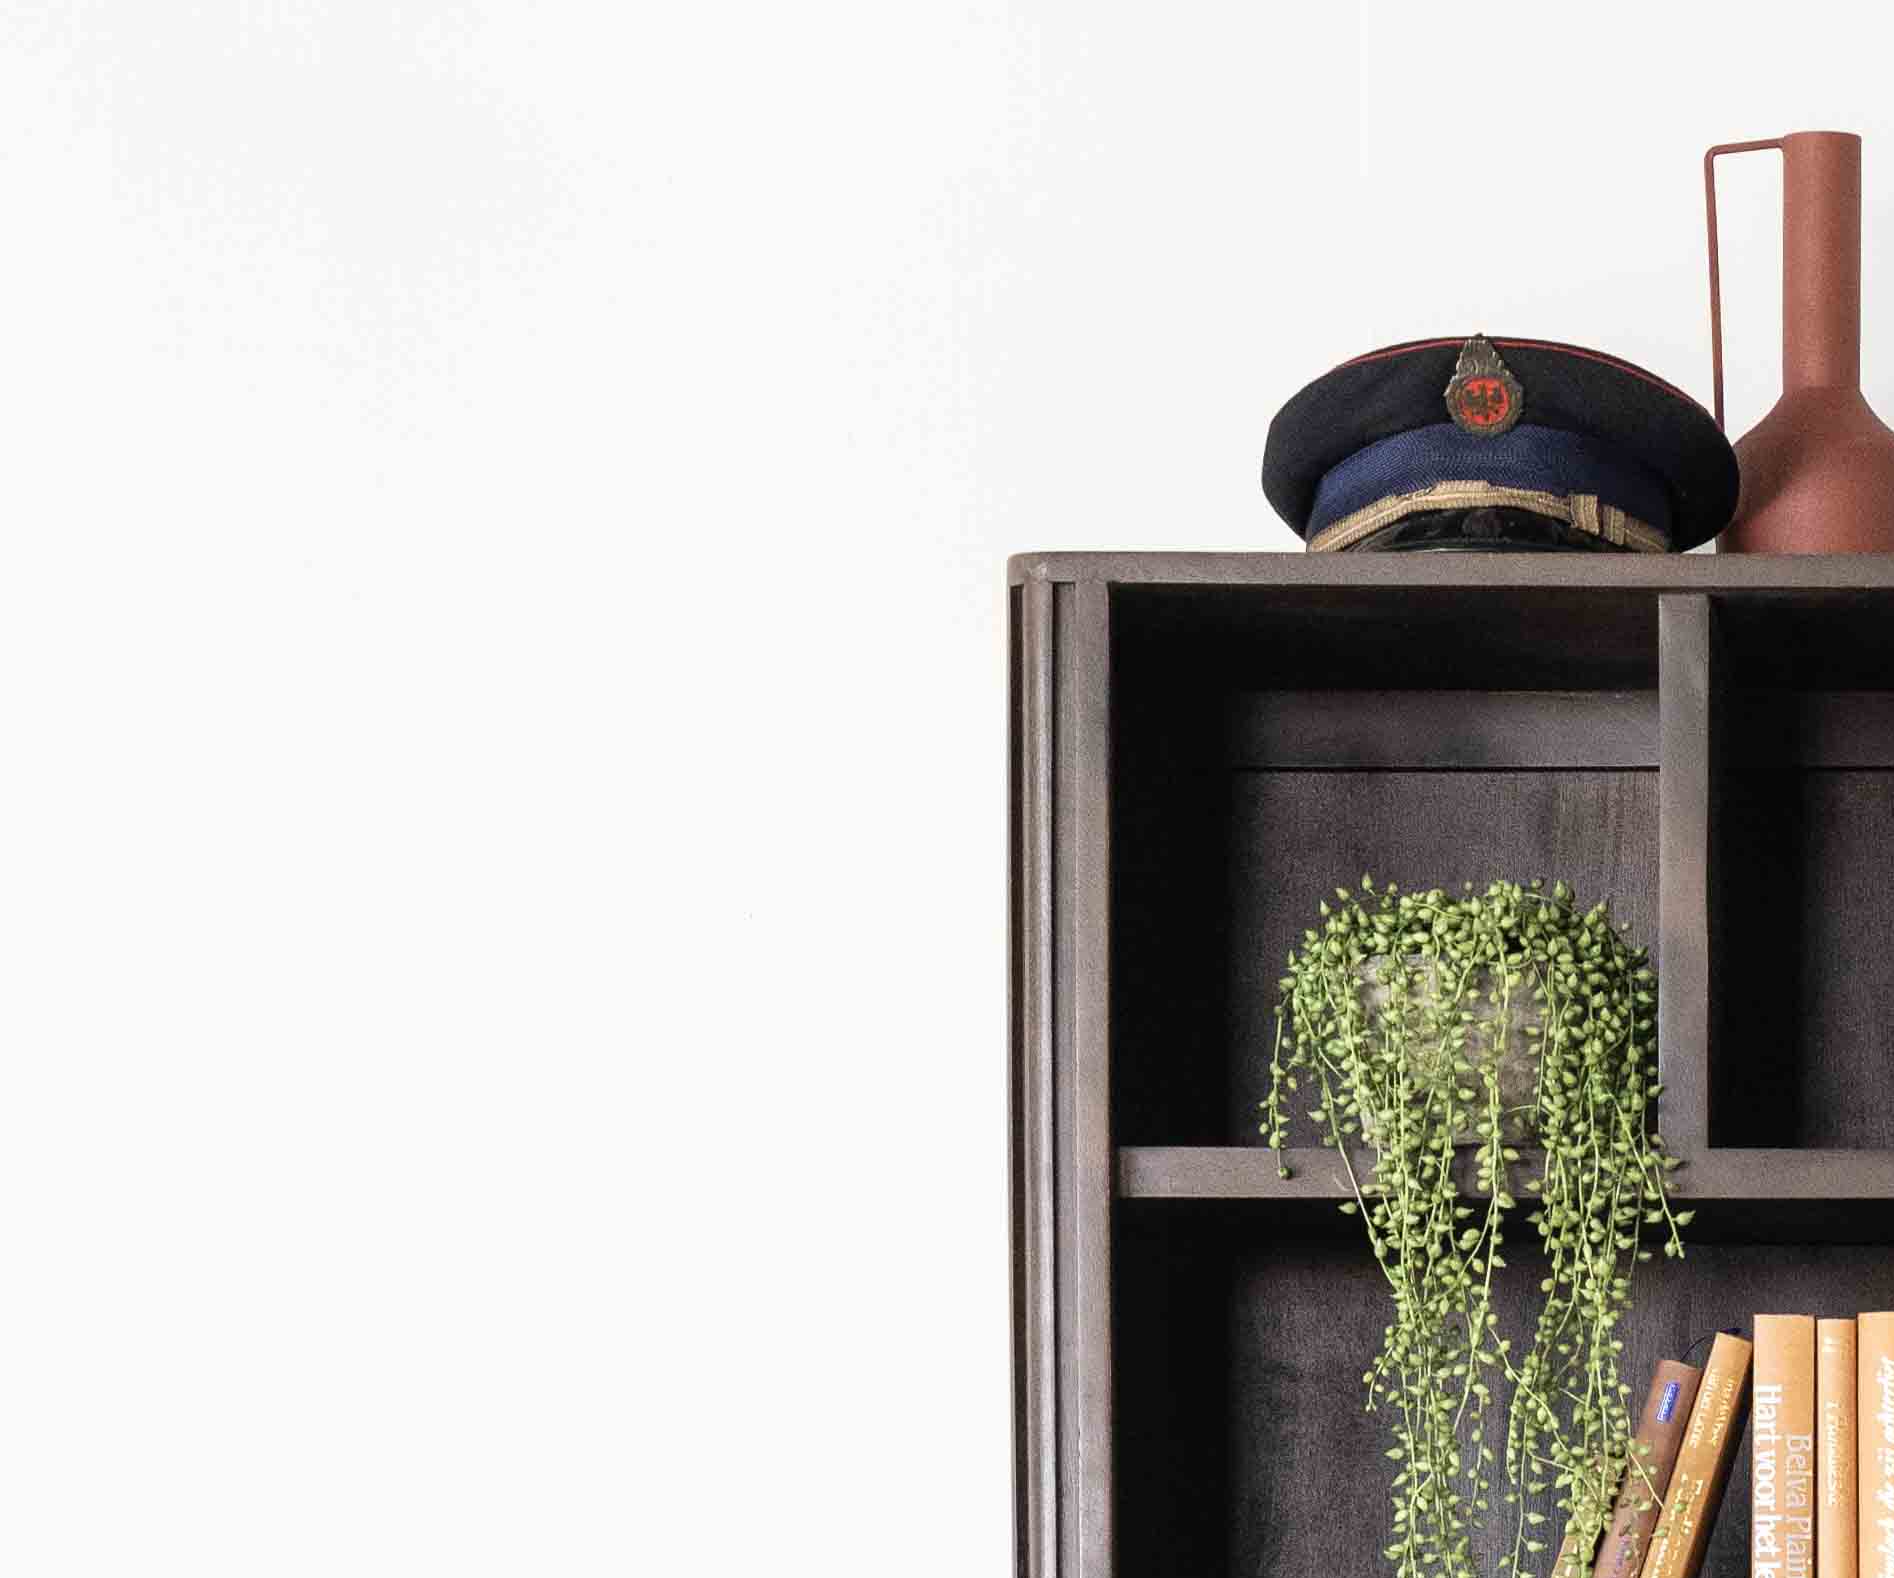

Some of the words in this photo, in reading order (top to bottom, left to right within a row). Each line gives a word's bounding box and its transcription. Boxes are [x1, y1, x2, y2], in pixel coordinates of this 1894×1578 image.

[1754, 1384, 1782, 1448] Hart
[1754, 1449, 1777, 1513] voor
[1784, 1434, 1811, 1511] Belva
[1754, 1515, 1781, 1557] het
